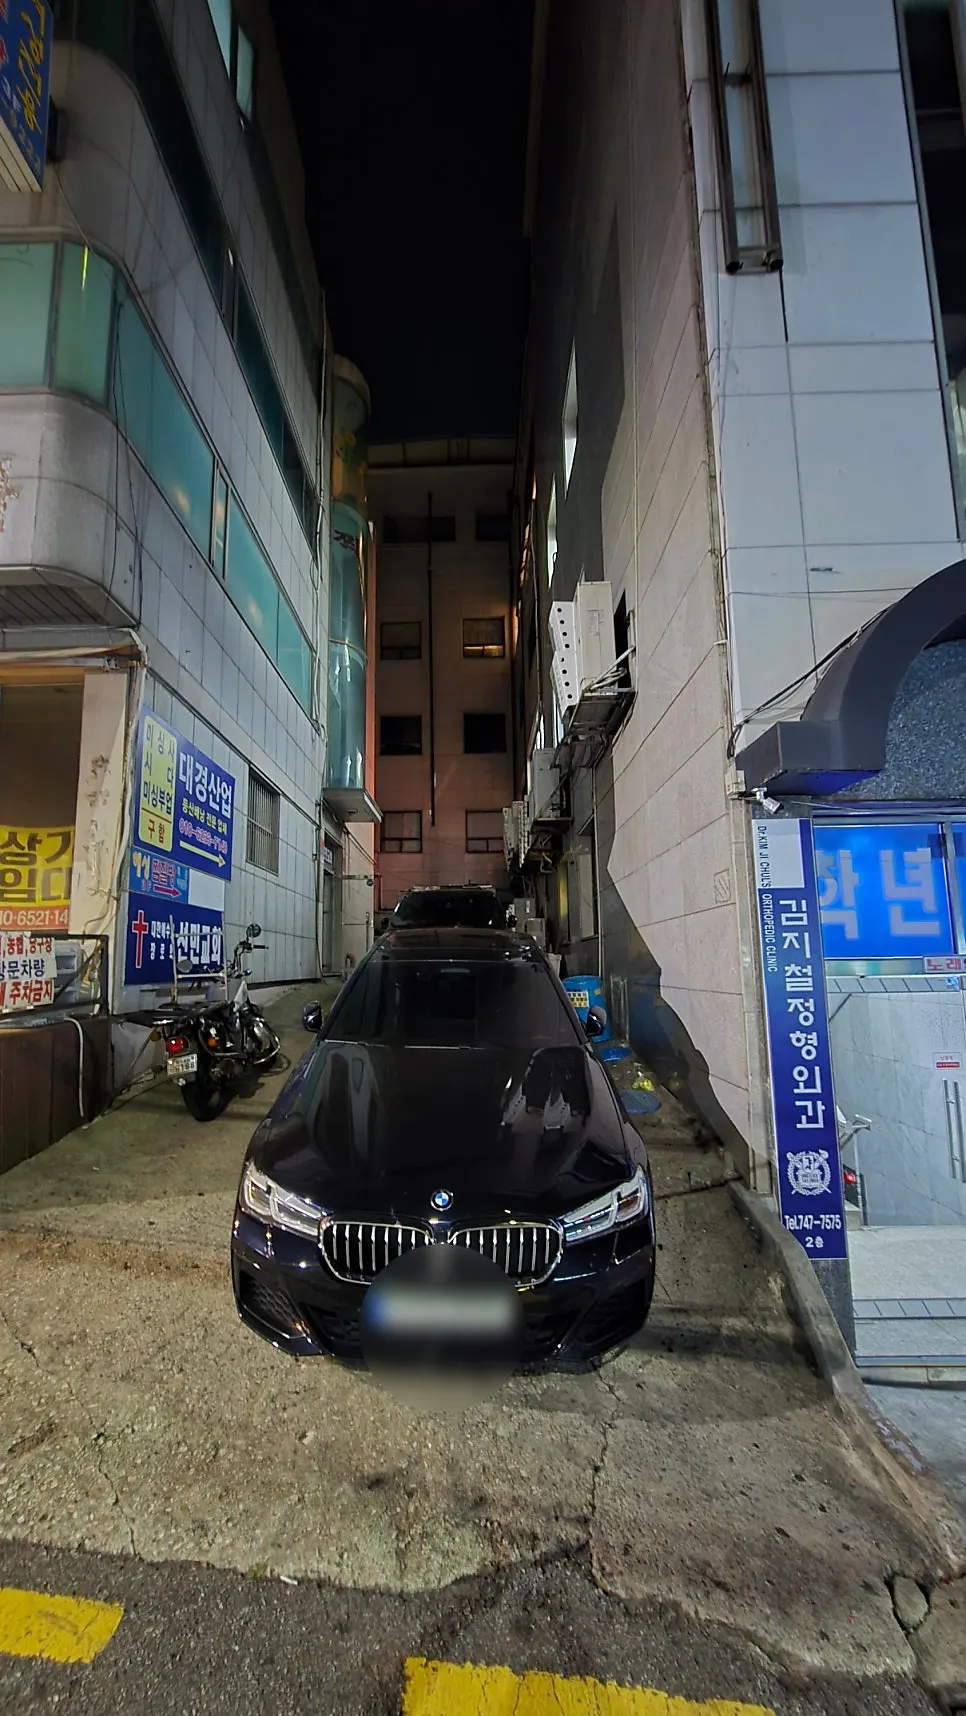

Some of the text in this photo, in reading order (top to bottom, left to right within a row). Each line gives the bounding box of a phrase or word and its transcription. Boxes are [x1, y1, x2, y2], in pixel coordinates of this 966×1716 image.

[143, 780, 172, 815] 미싱부업
[179, 752, 232, 819] 대경산업
[759, 851, 769, 859] JI
[762, 893, 777, 943] ORTHOPEDIC
[766, 946, 778, 973] CLINIC
[10, 980, 53, 1005] 주차금지
[779, 900, 826, 1129] 김지철정형외과
